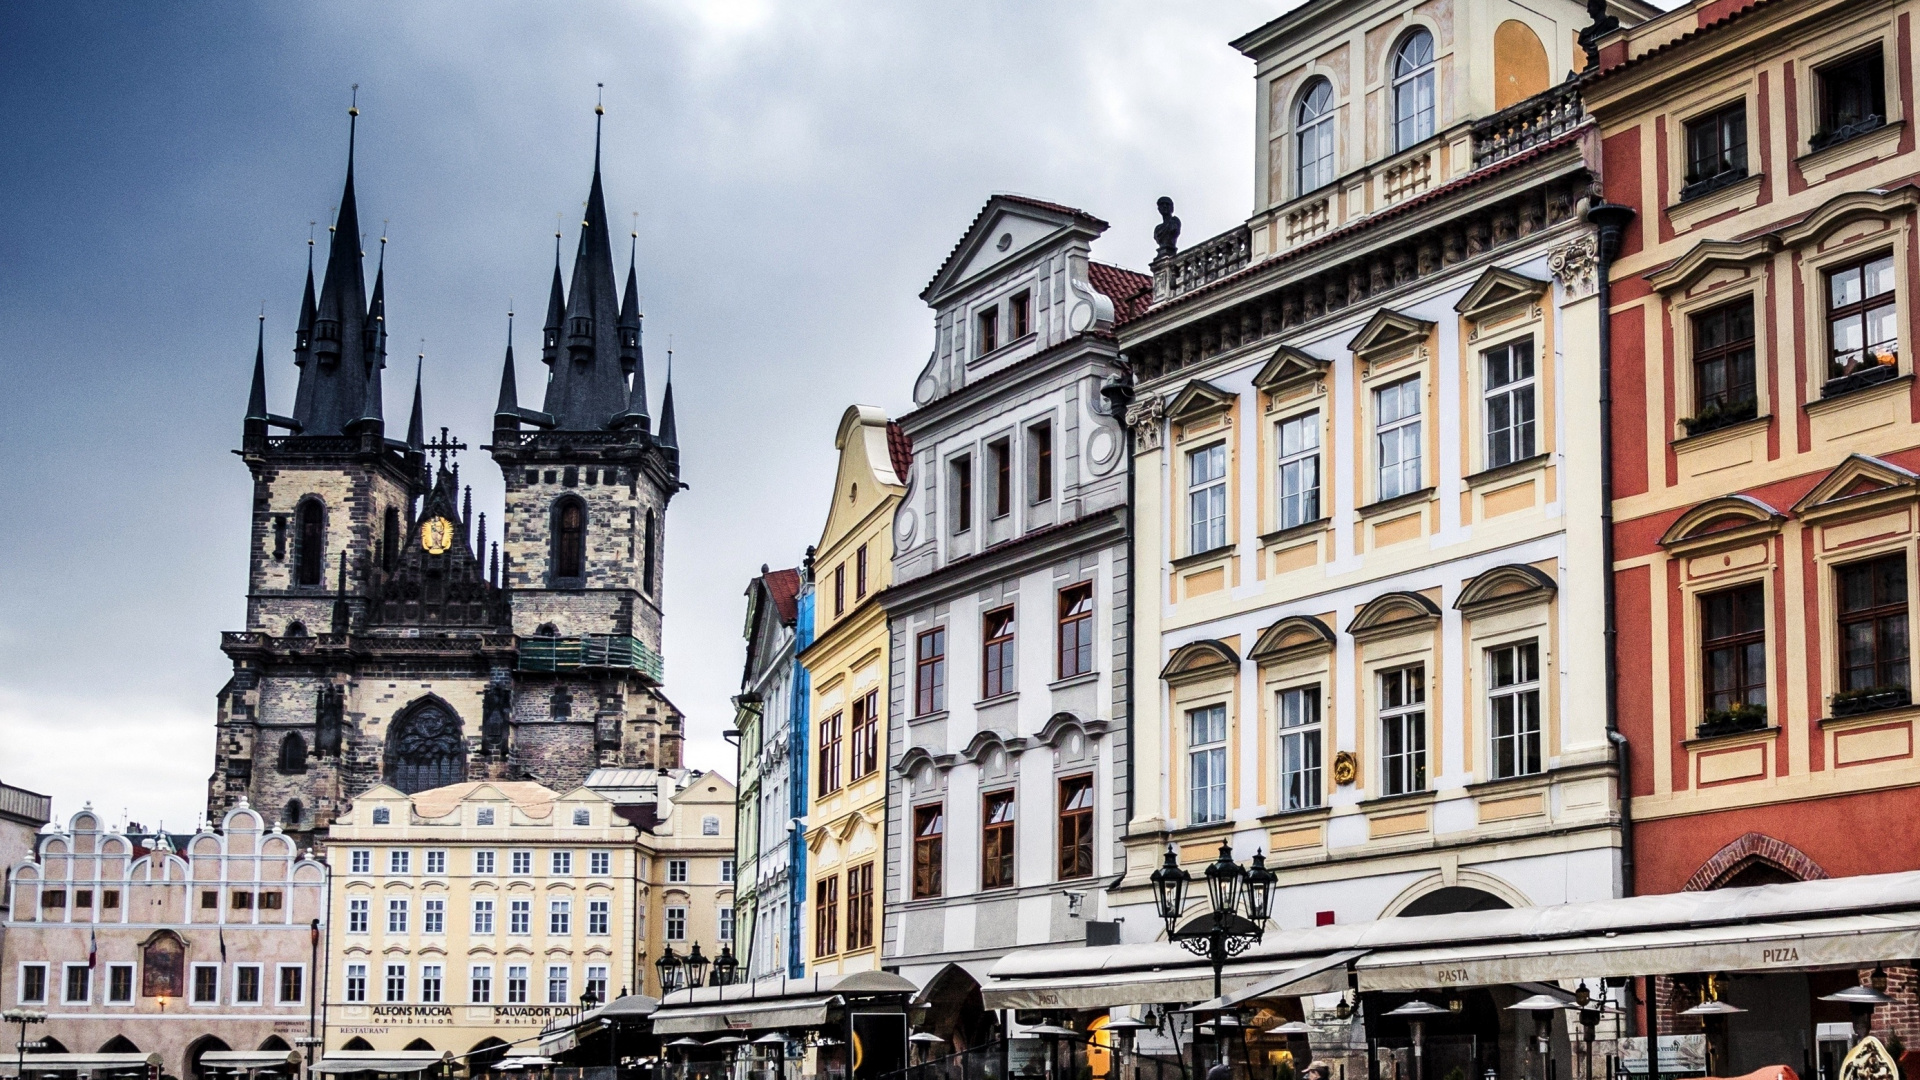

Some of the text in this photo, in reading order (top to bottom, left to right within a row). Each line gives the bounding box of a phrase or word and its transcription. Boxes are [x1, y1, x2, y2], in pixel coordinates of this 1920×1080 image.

[1763, 947, 1799, 963] PIZZA
[1438, 969, 1469, 982] PASTA
[1038, 994, 1059, 1005] PASTA
[373, 1006, 452, 1016] ALFONS MUCHA
[495, 1007, 551, 1016] SALVADOR
